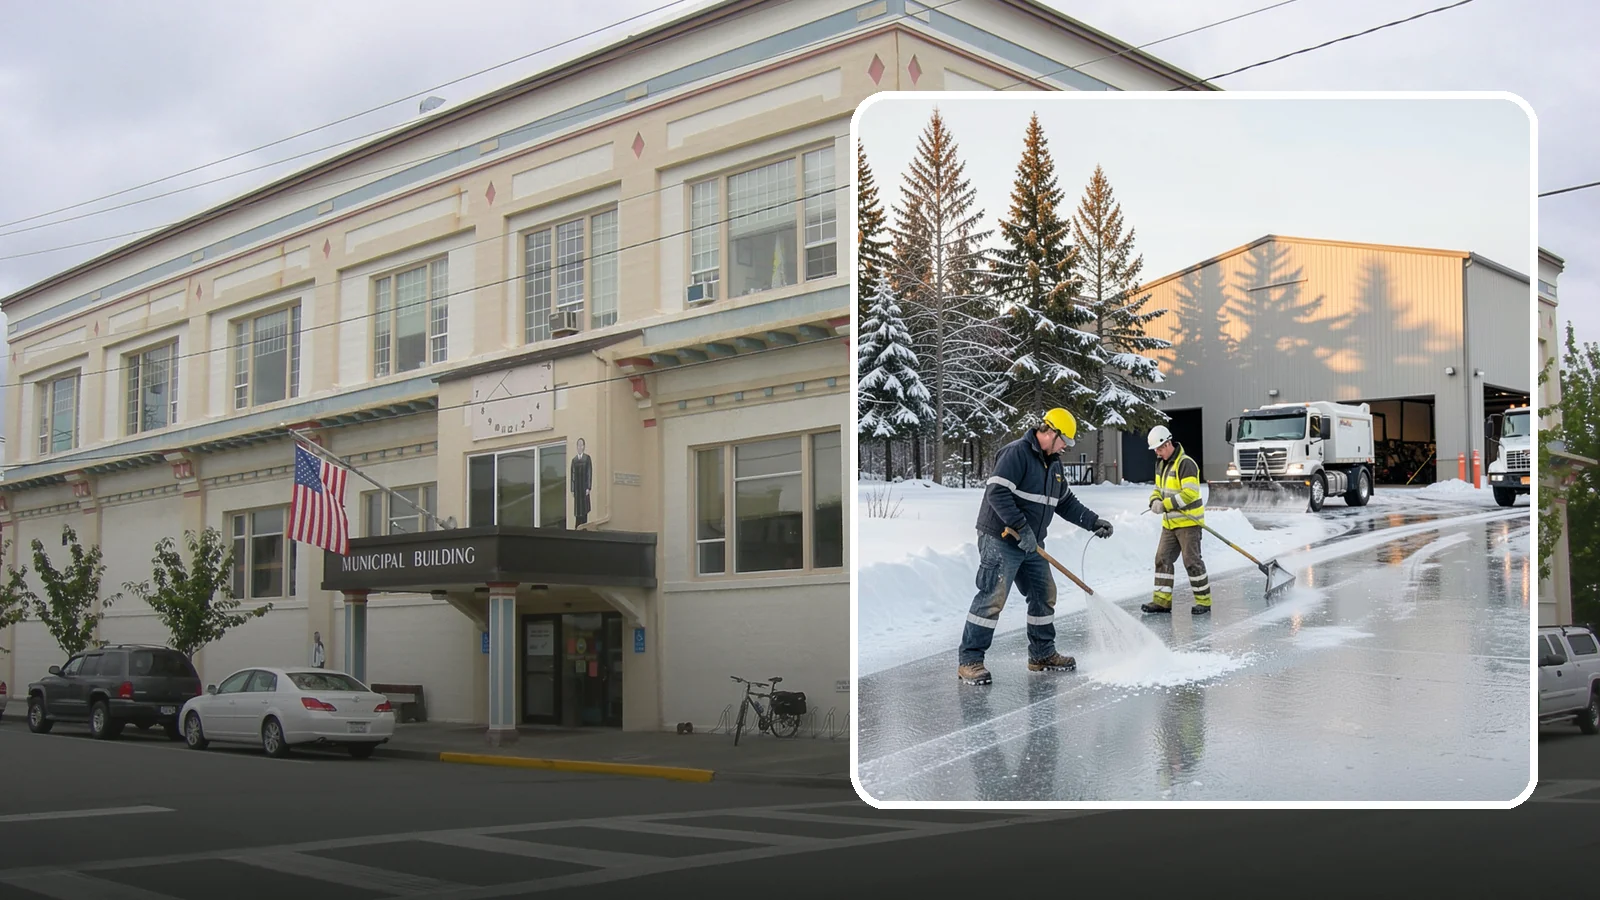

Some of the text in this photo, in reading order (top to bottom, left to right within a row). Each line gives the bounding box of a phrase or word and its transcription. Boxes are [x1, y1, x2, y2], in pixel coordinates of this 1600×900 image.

[480, 407, 485, 415] 8
[487, 418, 492, 426] 9
[501, 425, 506, 433] 11
[521, 420, 525, 428] 2
[529, 414, 533, 422] 3
[536, 402, 540, 410] 4
[342, 546, 475, 572] MUNICIPAL BUILDING
